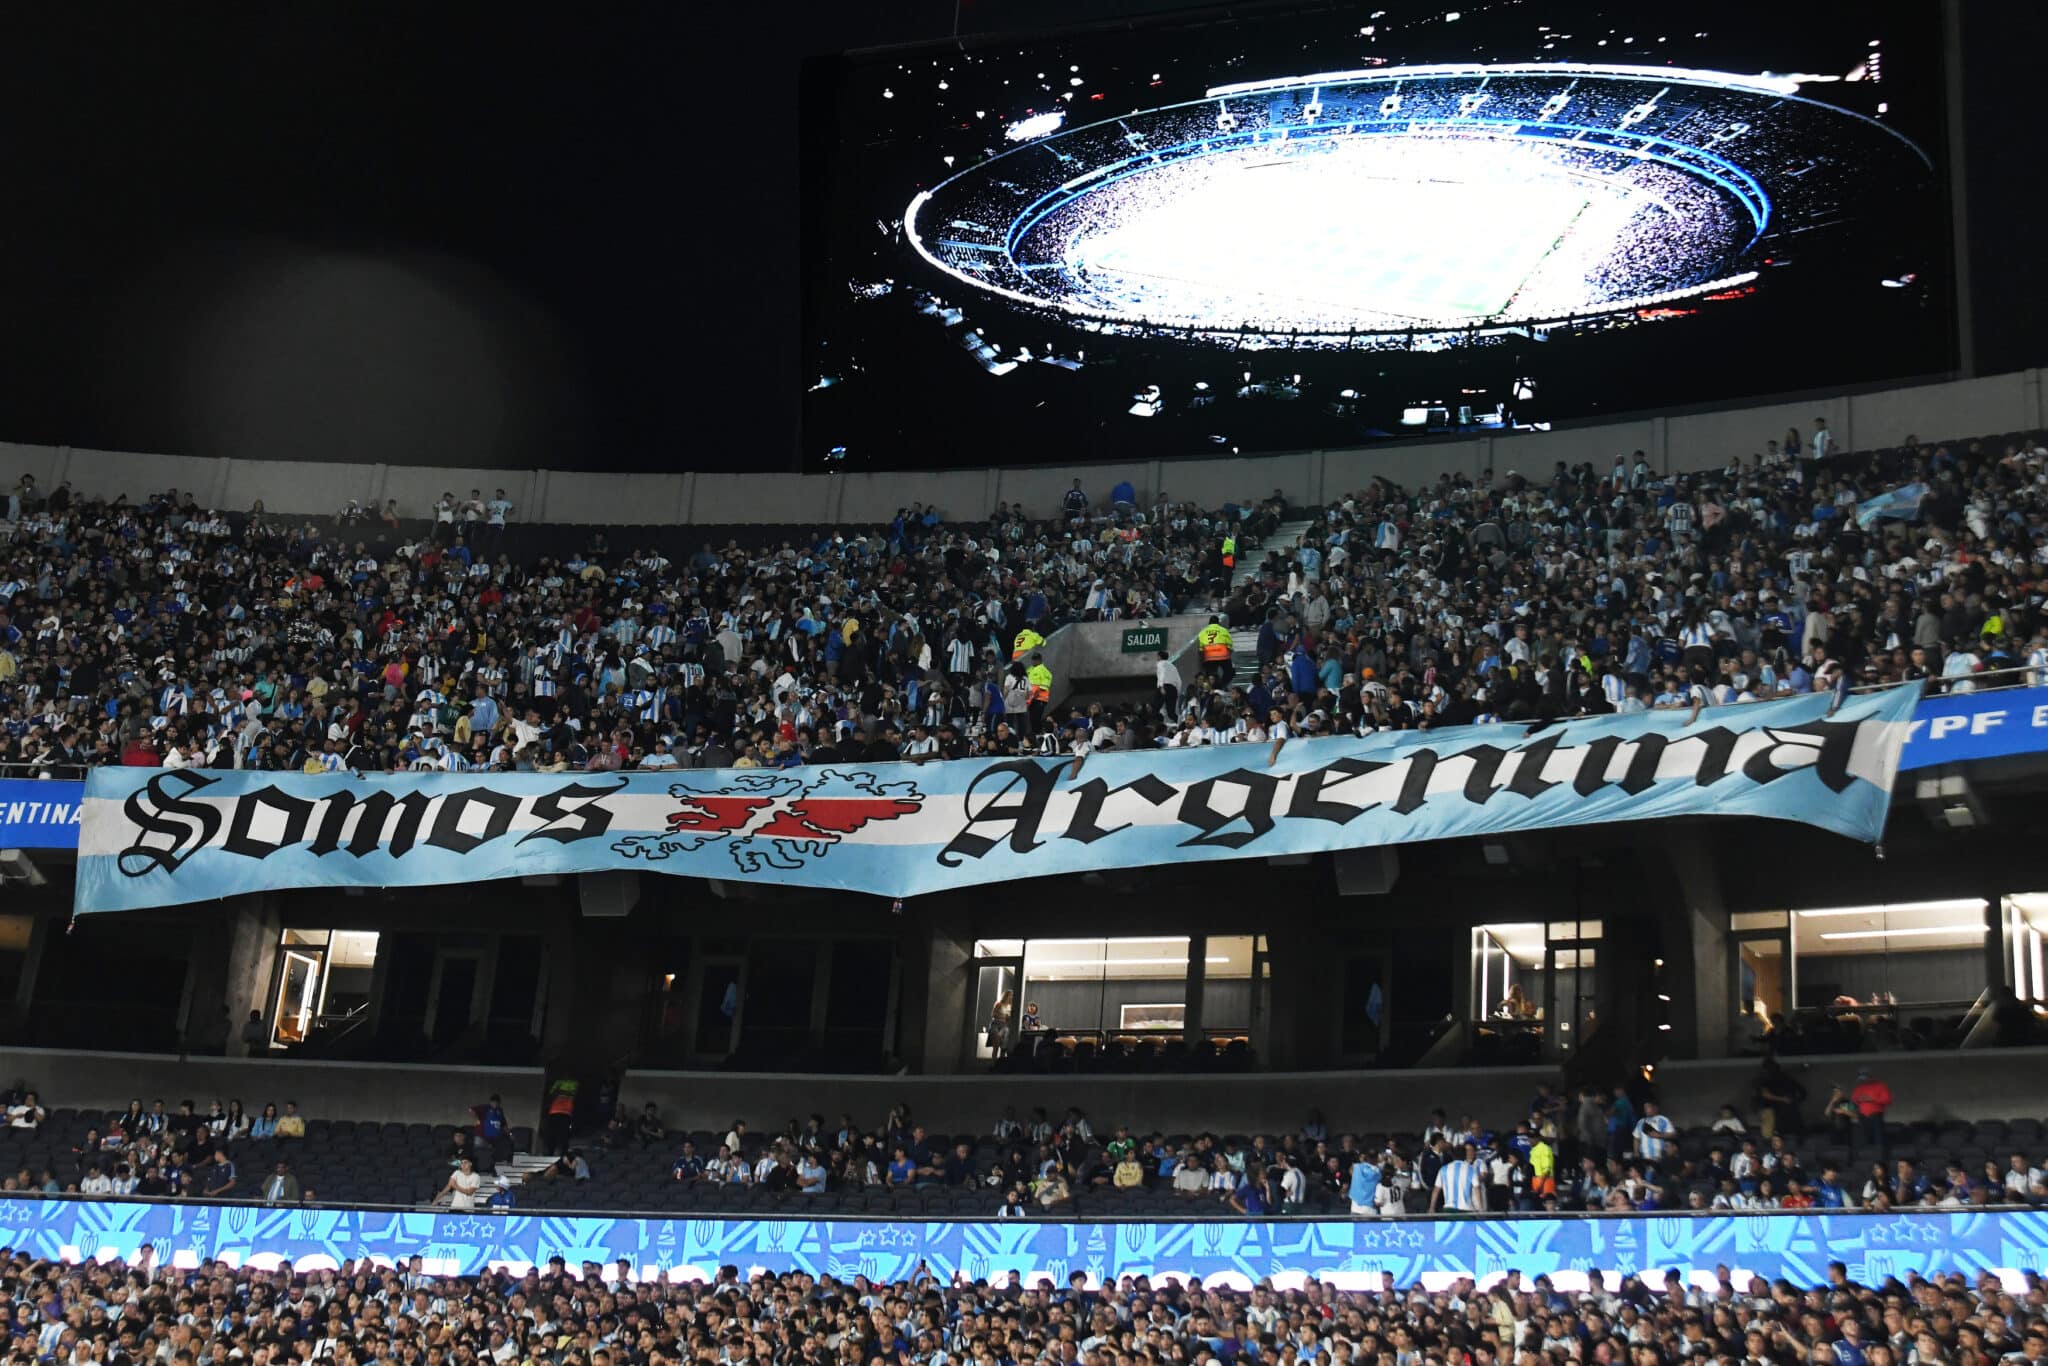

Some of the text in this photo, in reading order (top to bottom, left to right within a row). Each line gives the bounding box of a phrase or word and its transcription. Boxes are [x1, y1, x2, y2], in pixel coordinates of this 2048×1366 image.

[1127, 633, 1161, 646] SALIDA
[118, 711, 1880, 877] Somos Argentina
[1390, 1186, 1401, 1203] 10
